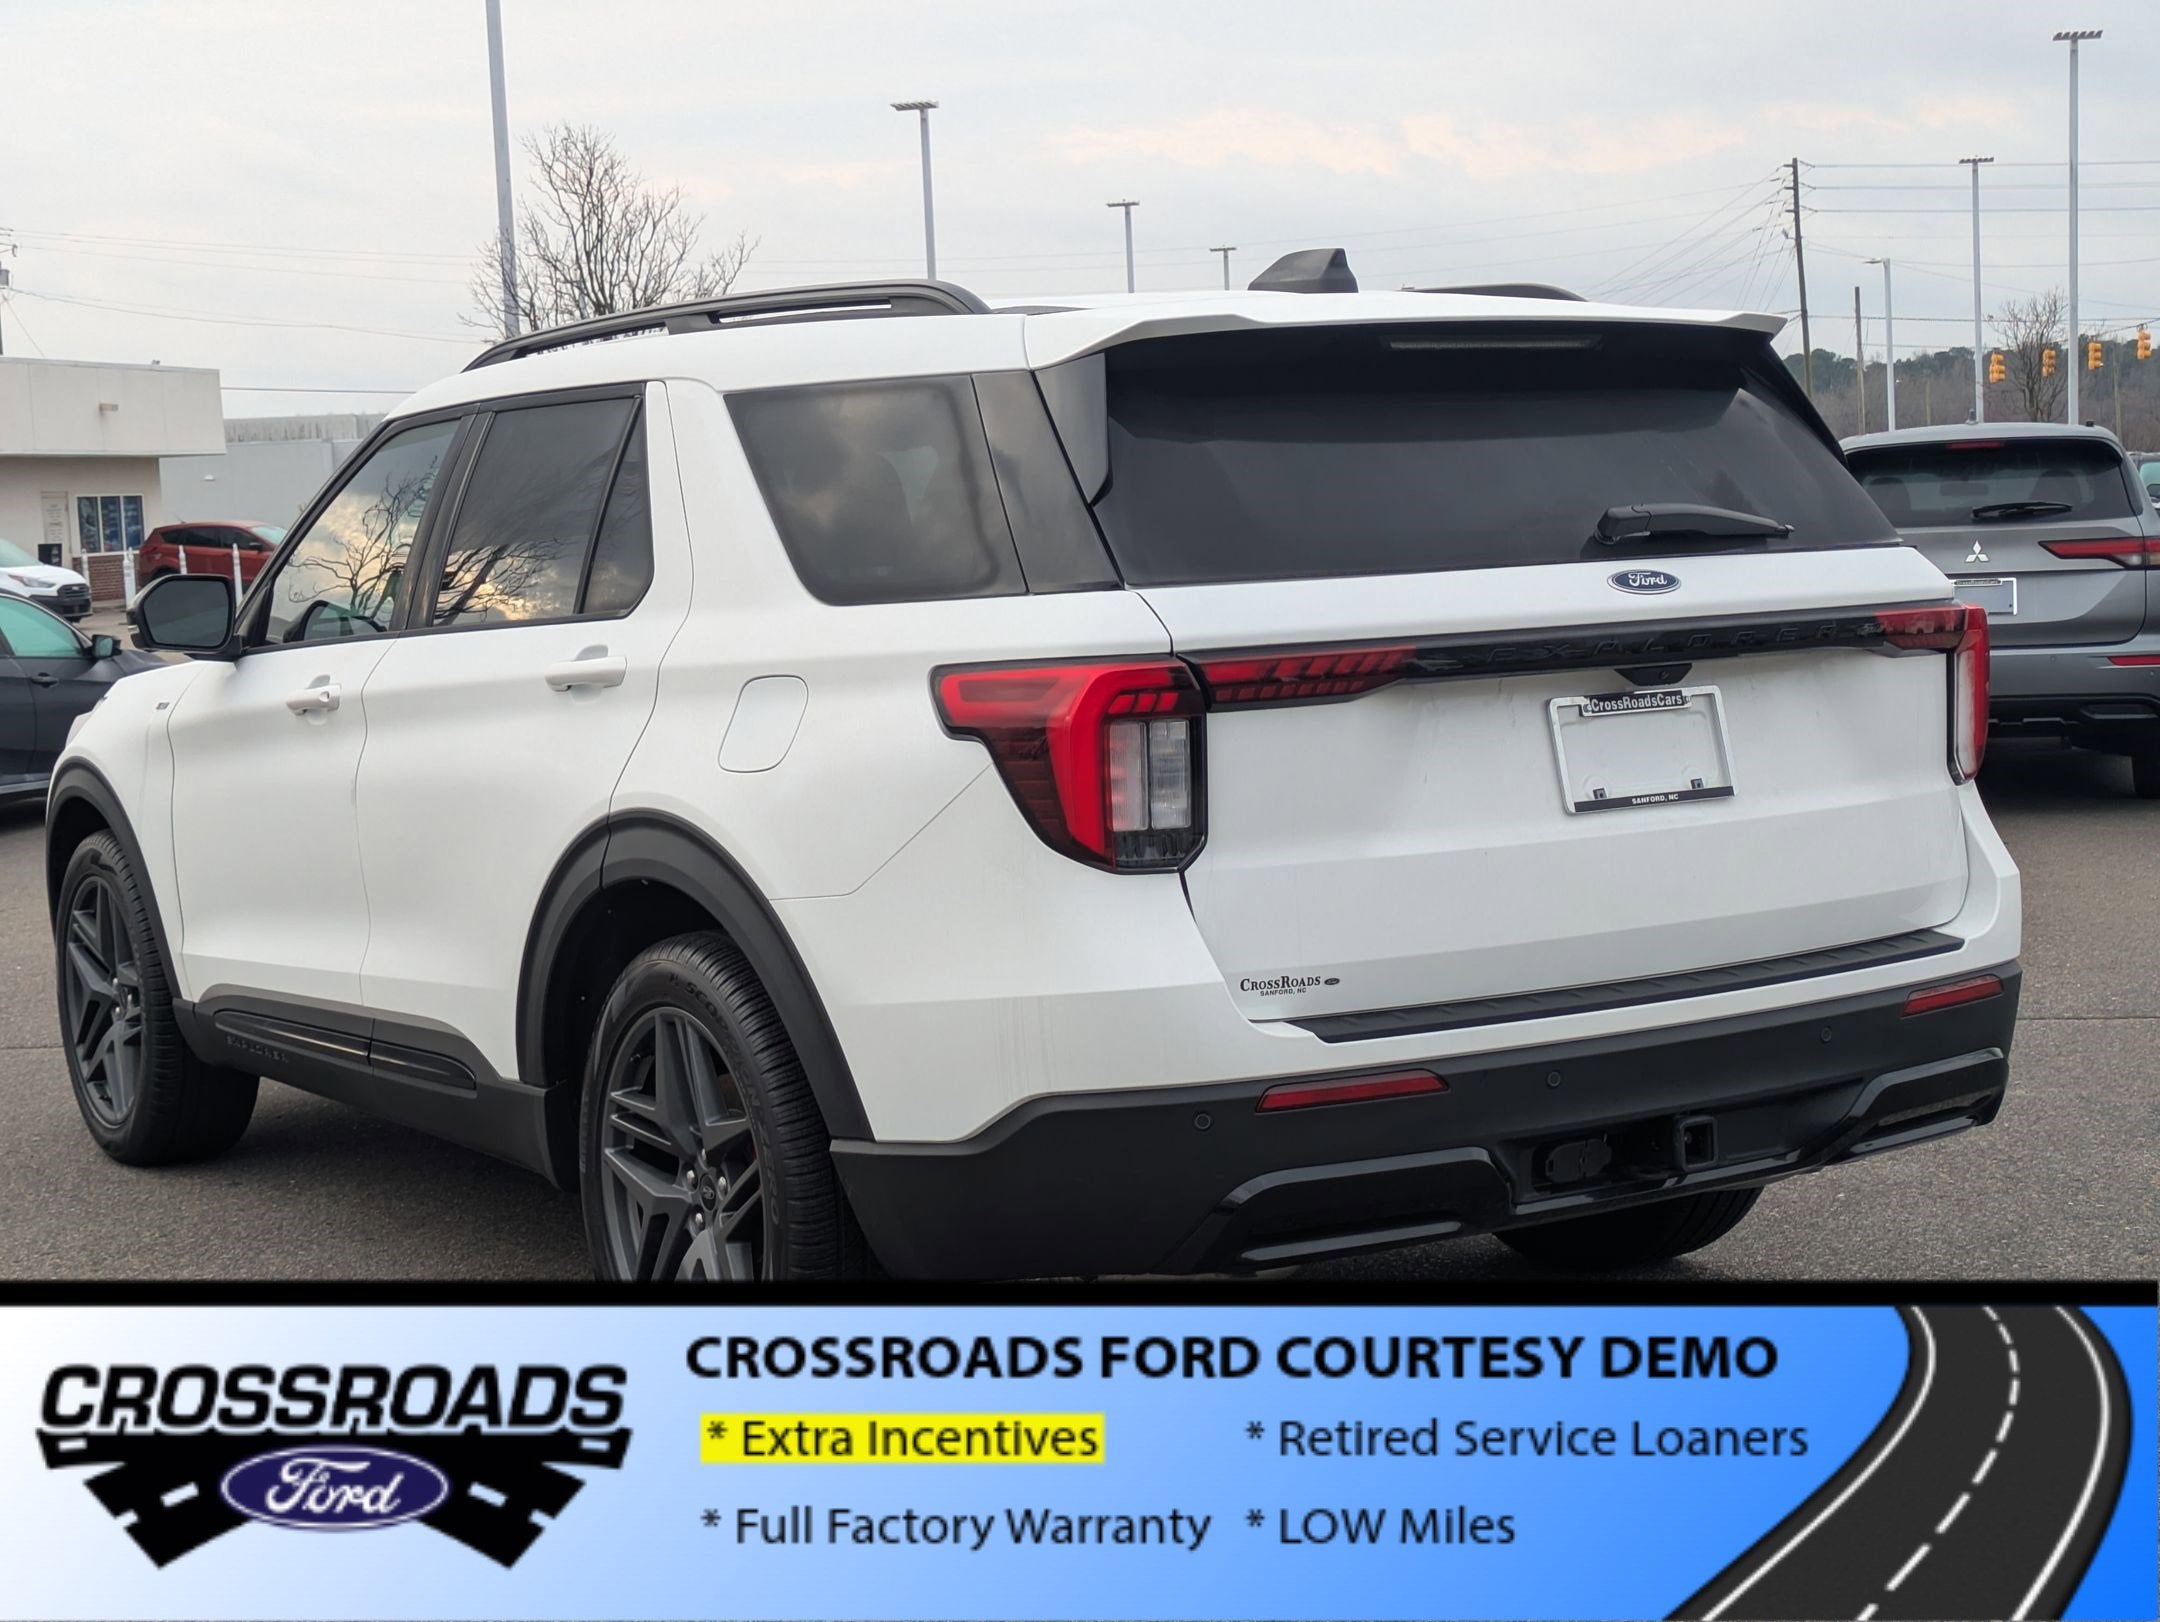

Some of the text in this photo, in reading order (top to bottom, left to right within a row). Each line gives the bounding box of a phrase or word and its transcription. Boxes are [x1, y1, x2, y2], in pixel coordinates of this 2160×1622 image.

[1628, 571, 1668, 587] Ford
[1591, 693, 1682, 712] CrossRoadsCars
[1632, 793, 1679, 804] SANFORD, NC
[1260, 988, 1295, 997] SANFORD,
